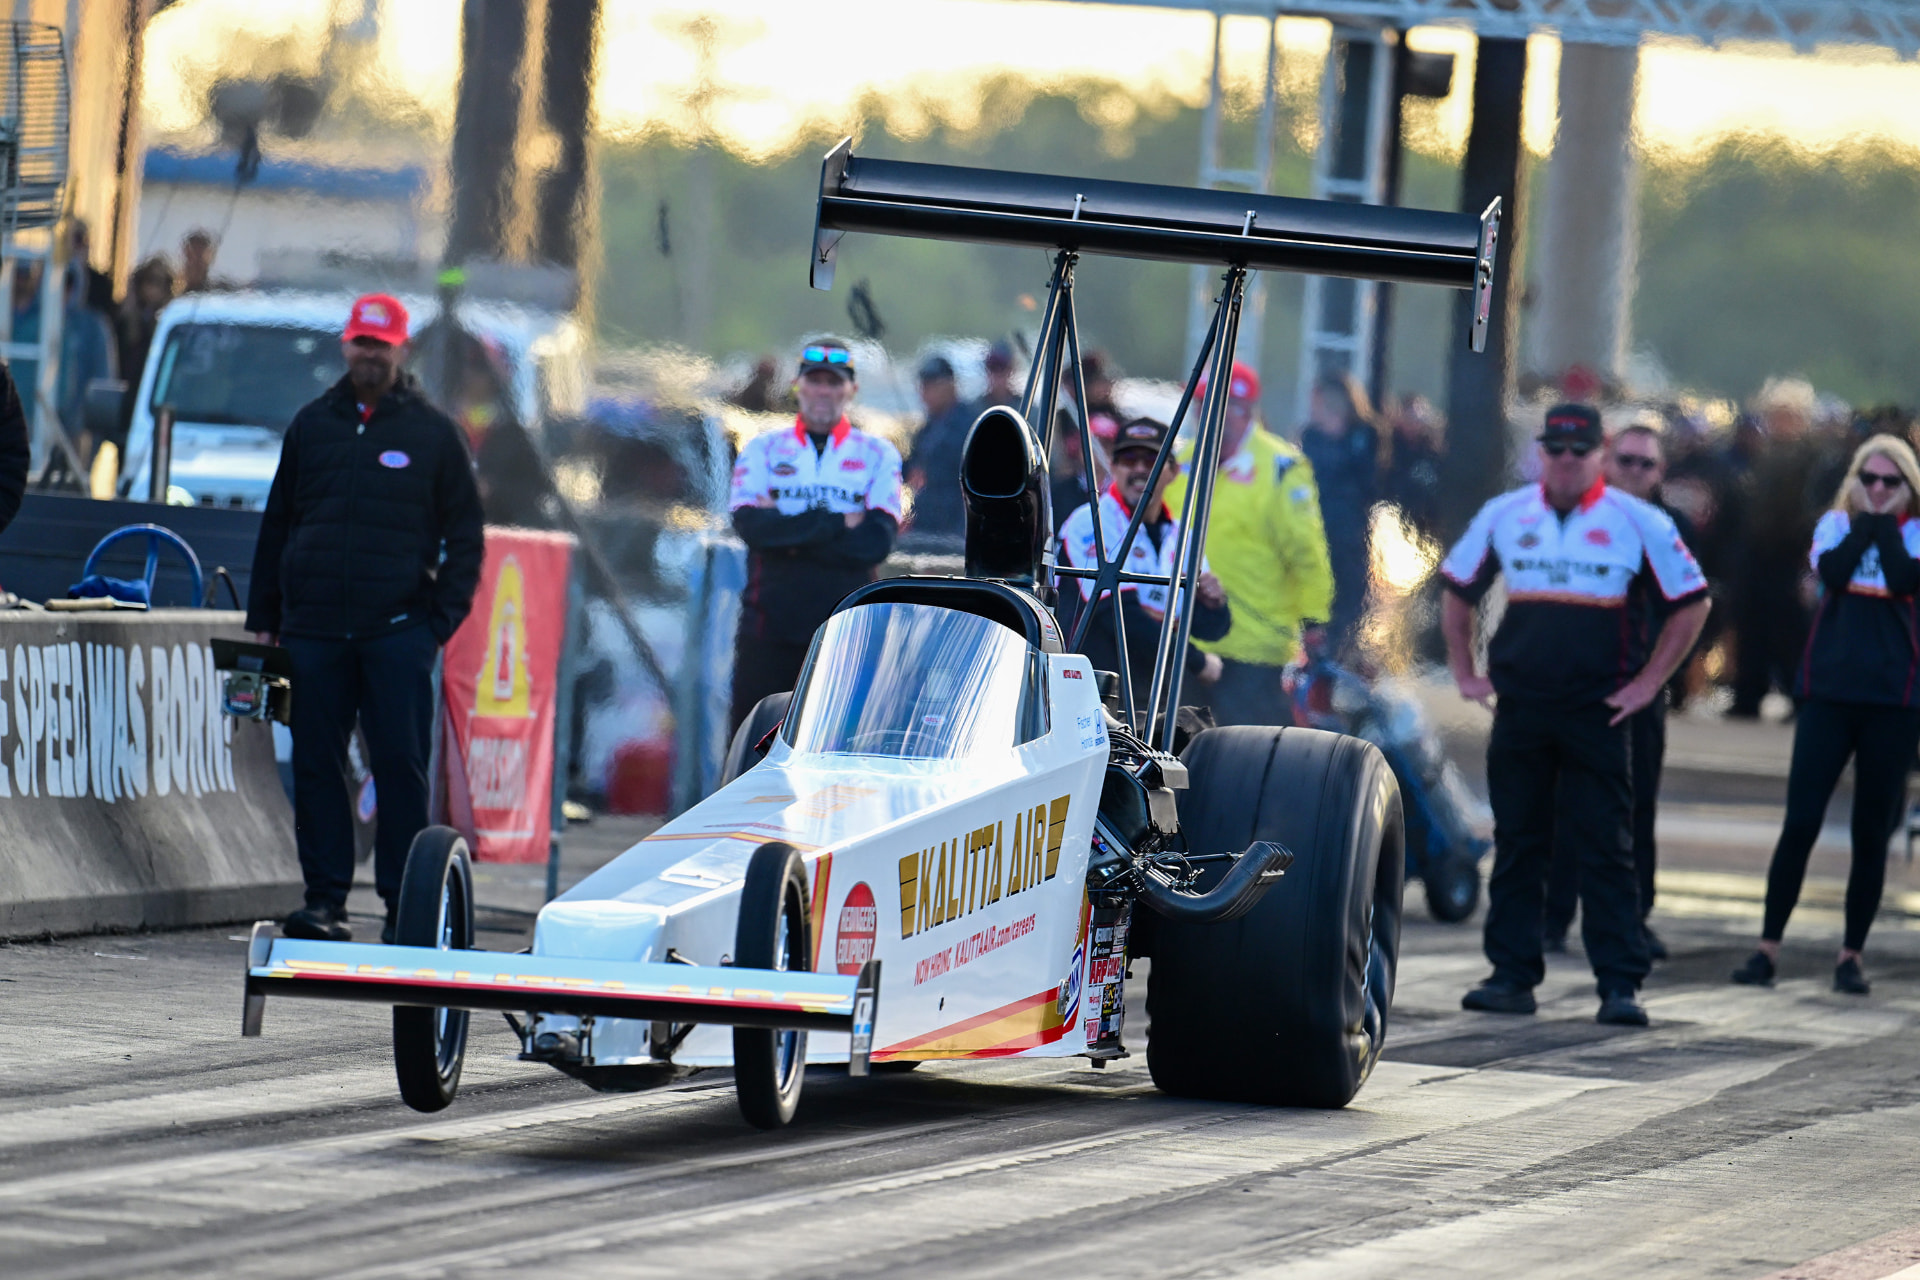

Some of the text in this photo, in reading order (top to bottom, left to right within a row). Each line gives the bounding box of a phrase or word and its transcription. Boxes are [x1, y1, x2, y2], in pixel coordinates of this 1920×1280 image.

[13, 641, 88, 798] SPEED
[86, 642, 147, 804] WAS
[917, 820, 1003, 936] KALITTA
[1006, 803, 1047, 898] AIR
[837, 938, 874, 964] EQUIPMENT
[914, 957, 931, 987] NOW
[929, 947, 952, 980] HIRING
[954, 913, 1036, 969] KALITTAAIR.com/careers
[1090, 960, 1108, 984] ARP
